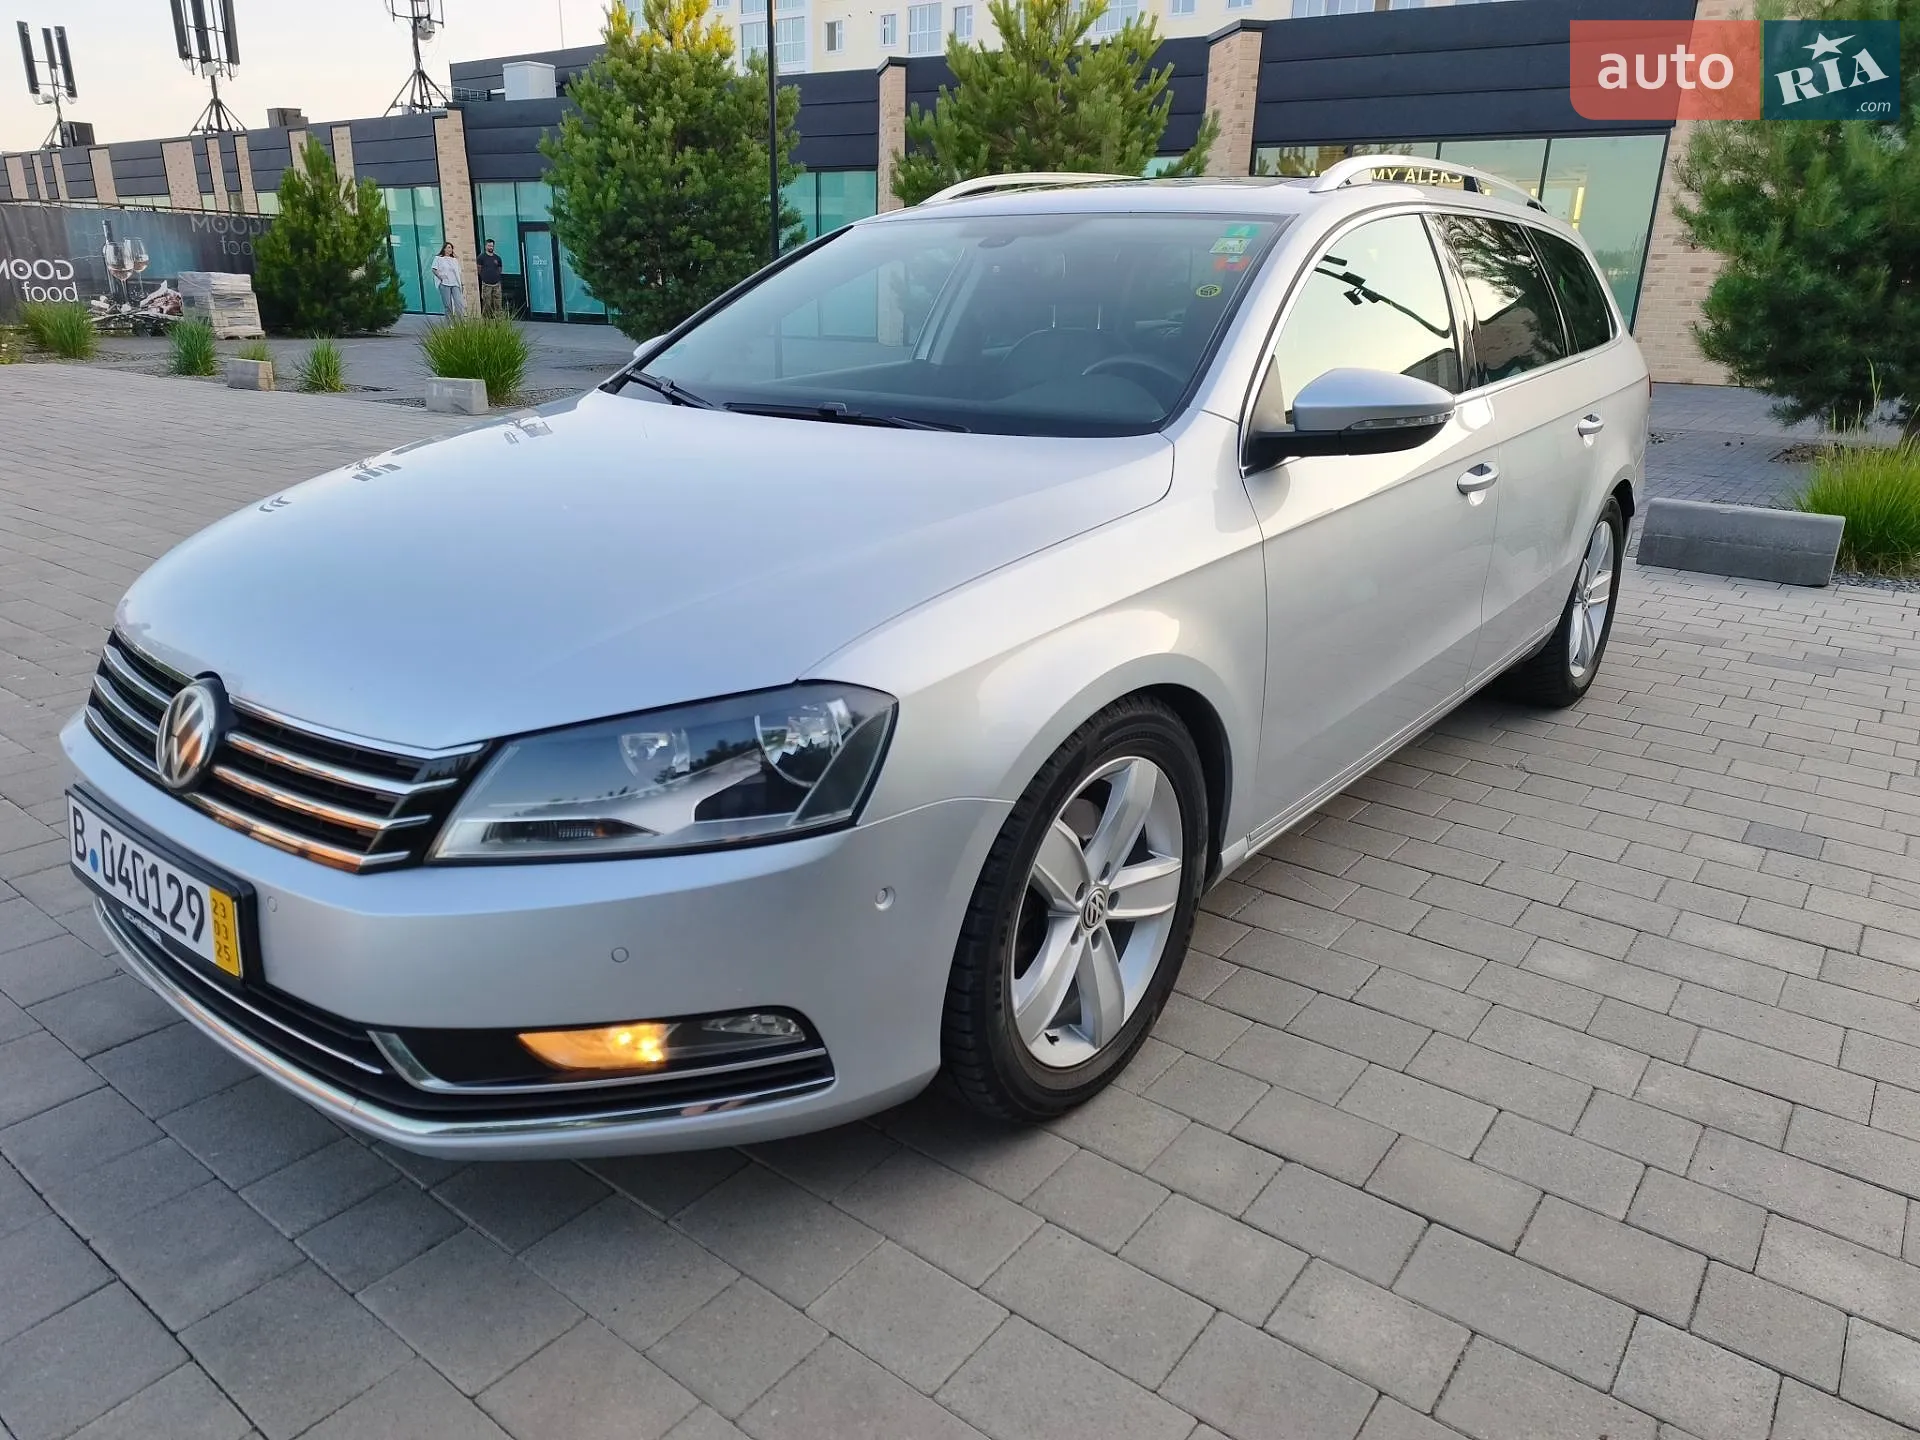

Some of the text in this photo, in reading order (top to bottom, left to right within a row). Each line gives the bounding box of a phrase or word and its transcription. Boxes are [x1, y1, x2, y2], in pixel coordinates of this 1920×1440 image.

[220, 235, 253, 255] foo
[21, 281, 79, 302] food
[72, 806, 87, 862] B
[101, 828, 205, 944] 040129
[212, 897, 226, 919] 23
[215, 940, 231, 962] 25
